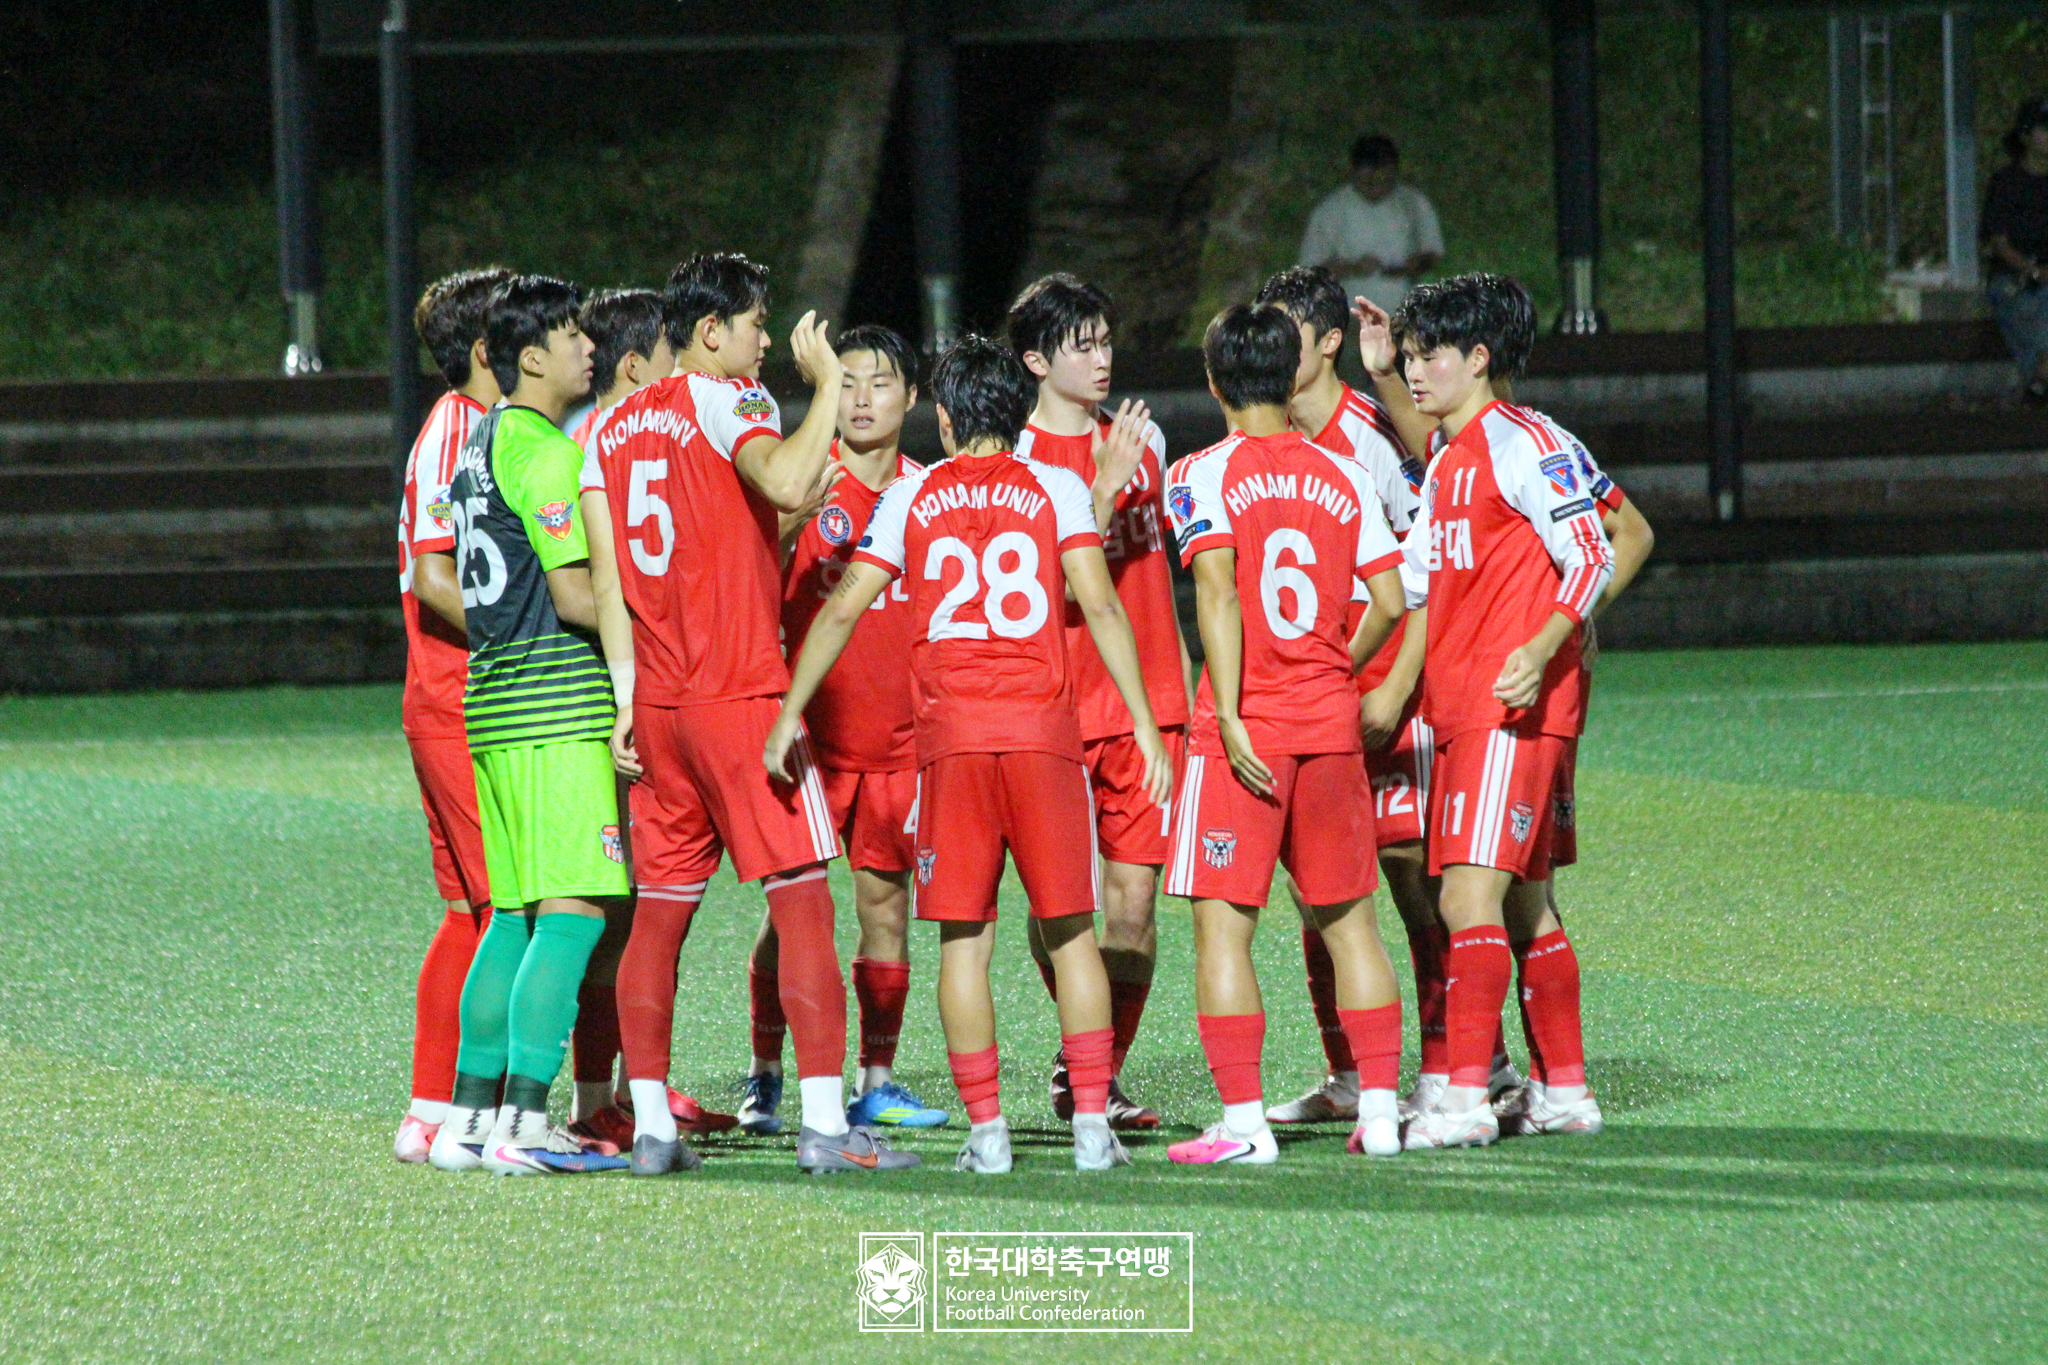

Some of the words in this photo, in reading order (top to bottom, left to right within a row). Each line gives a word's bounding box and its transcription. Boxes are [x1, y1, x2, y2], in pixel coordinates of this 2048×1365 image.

[911, 483, 988, 528] HONAM
[991, 482, 1047, 520] UNIV
[1225, 473, 1297, 517] HONAM
[1302, 474, 1359, 525] UNIV
[1452, 466, 1477, 506] 11
[627, 459, 675, 577] 5
[923, 531, 1050, 643] 28
[1260, 528, 1319, 640] 6
[1371, 772, 1414, 819] 12
[1441, 791, 1466, 836] 11
